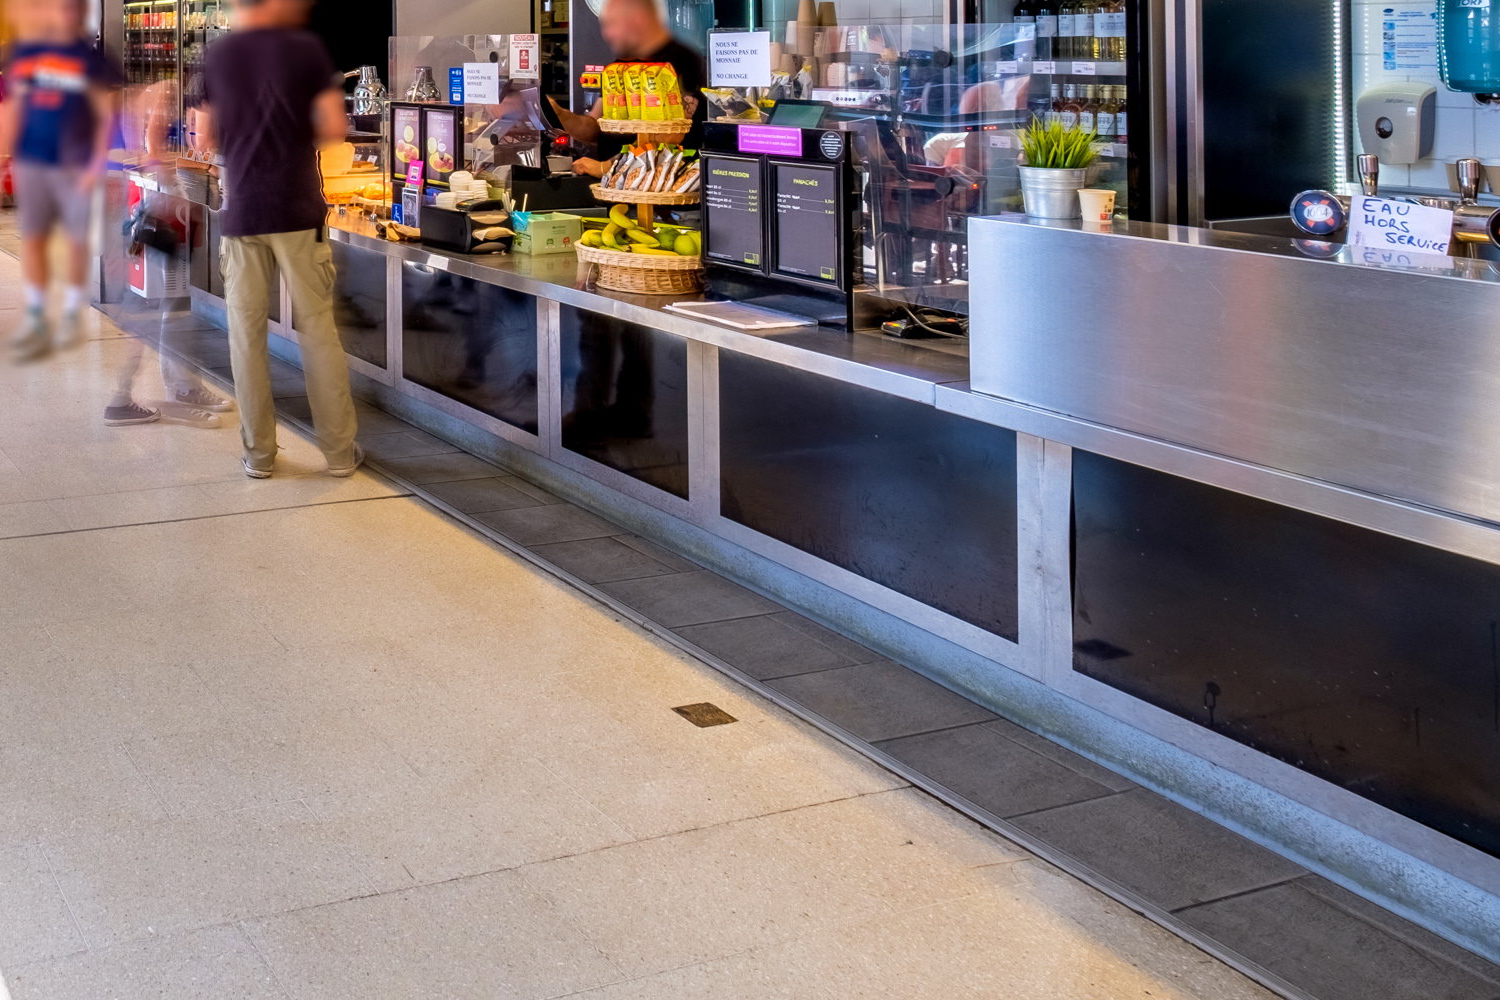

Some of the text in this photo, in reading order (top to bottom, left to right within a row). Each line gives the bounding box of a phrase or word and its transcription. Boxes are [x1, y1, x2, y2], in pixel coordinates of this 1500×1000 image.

[1306, 207, 1330, 218] 1664
[1362, 198, 1410, 216] EAU
[1364, 214, 1410, 234] HORS
